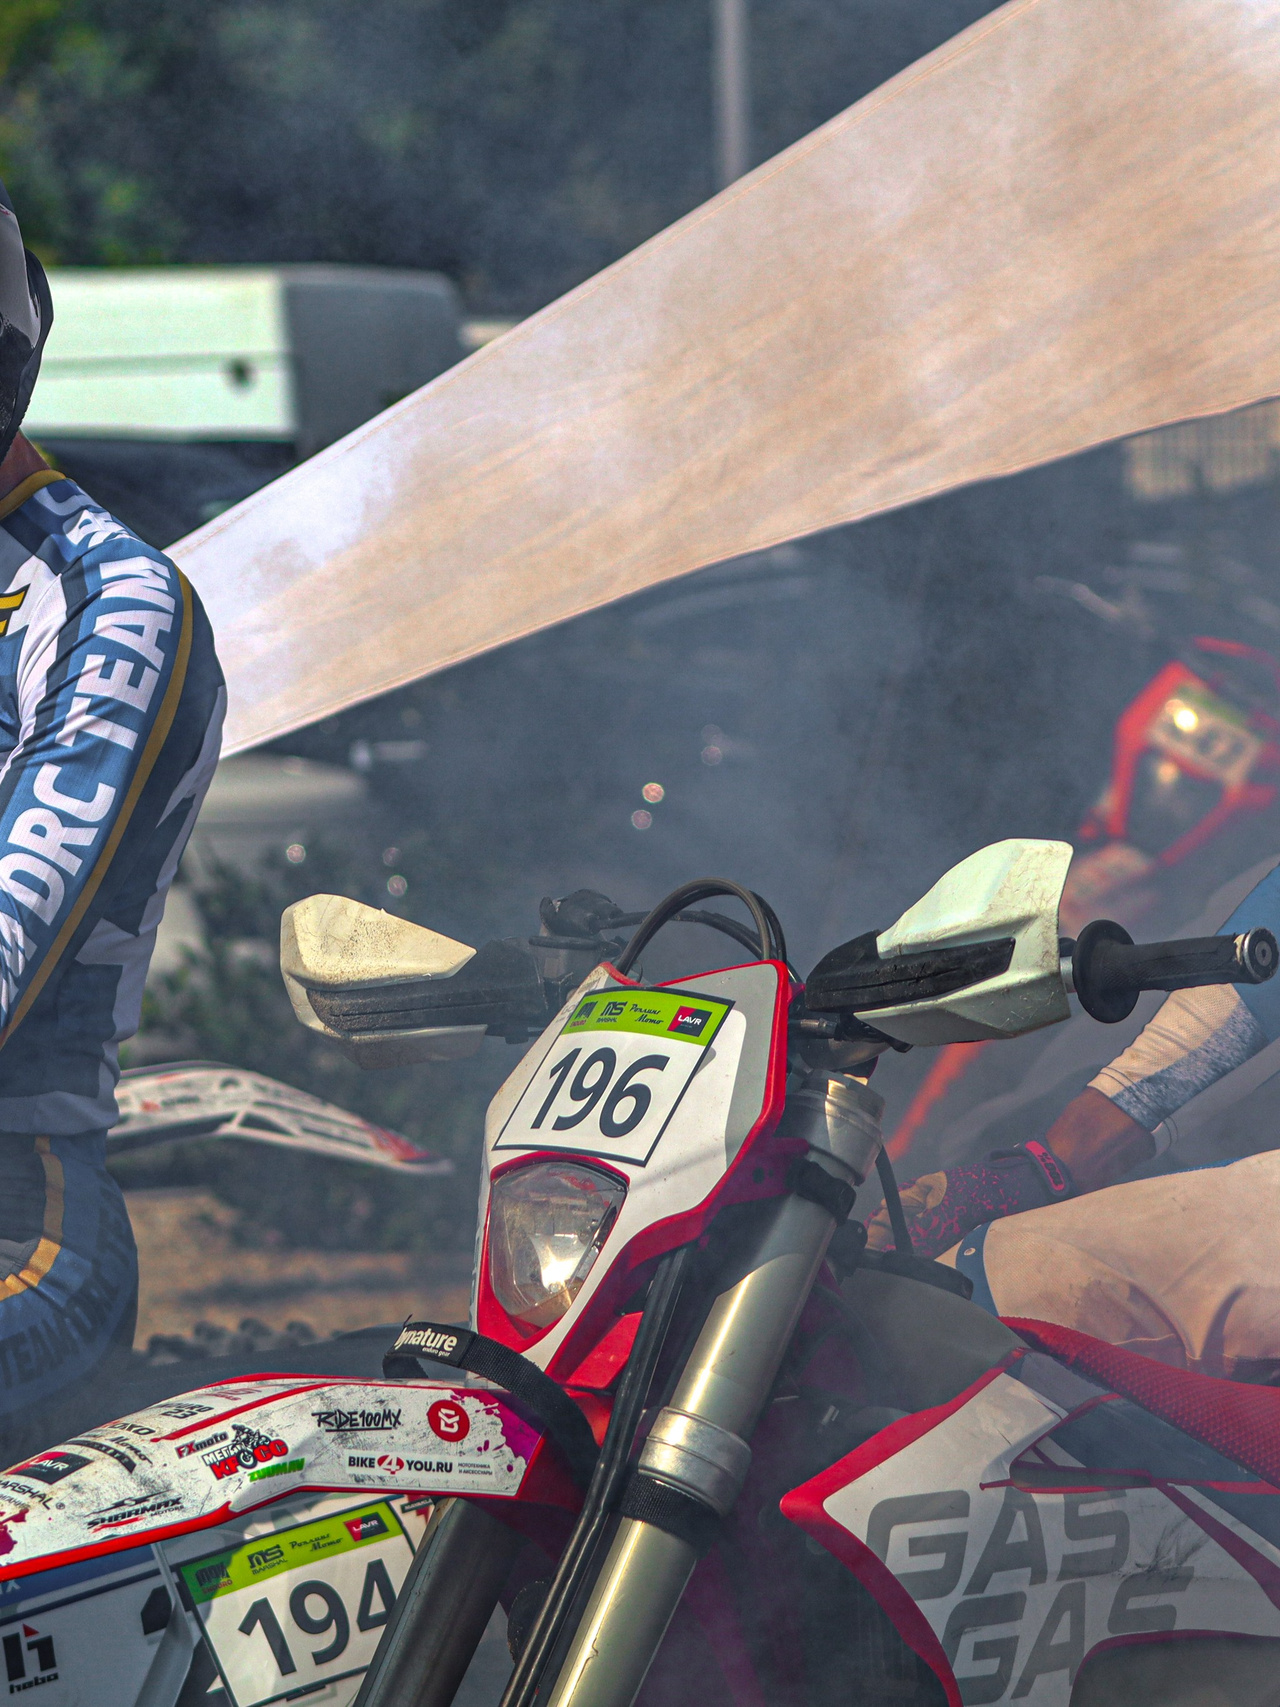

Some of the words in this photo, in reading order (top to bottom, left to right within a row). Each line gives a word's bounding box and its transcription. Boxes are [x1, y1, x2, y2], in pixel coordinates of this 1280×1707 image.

[53, 556, 175, 753] TEAM
[677, 1014, 703, 1026] LAVR
[530, 1046, 671, 1138] 196
[175, 1431, 229, 1459] FXmoto
[29, 1458, 69, 1472] LAVR
[86, 1497, 183, 1529] SHARMAX
[150, 1505, 185, 1518] MOTORS
[352, 1519, 379, 1533] LAVR
[866, 1489, 1131, 1602] GAS
[252, 1558, 288, 1575] MARSHAL
[238, 1557, 398, 1677] 194
[9, 1672, 59, 1694] hebo
